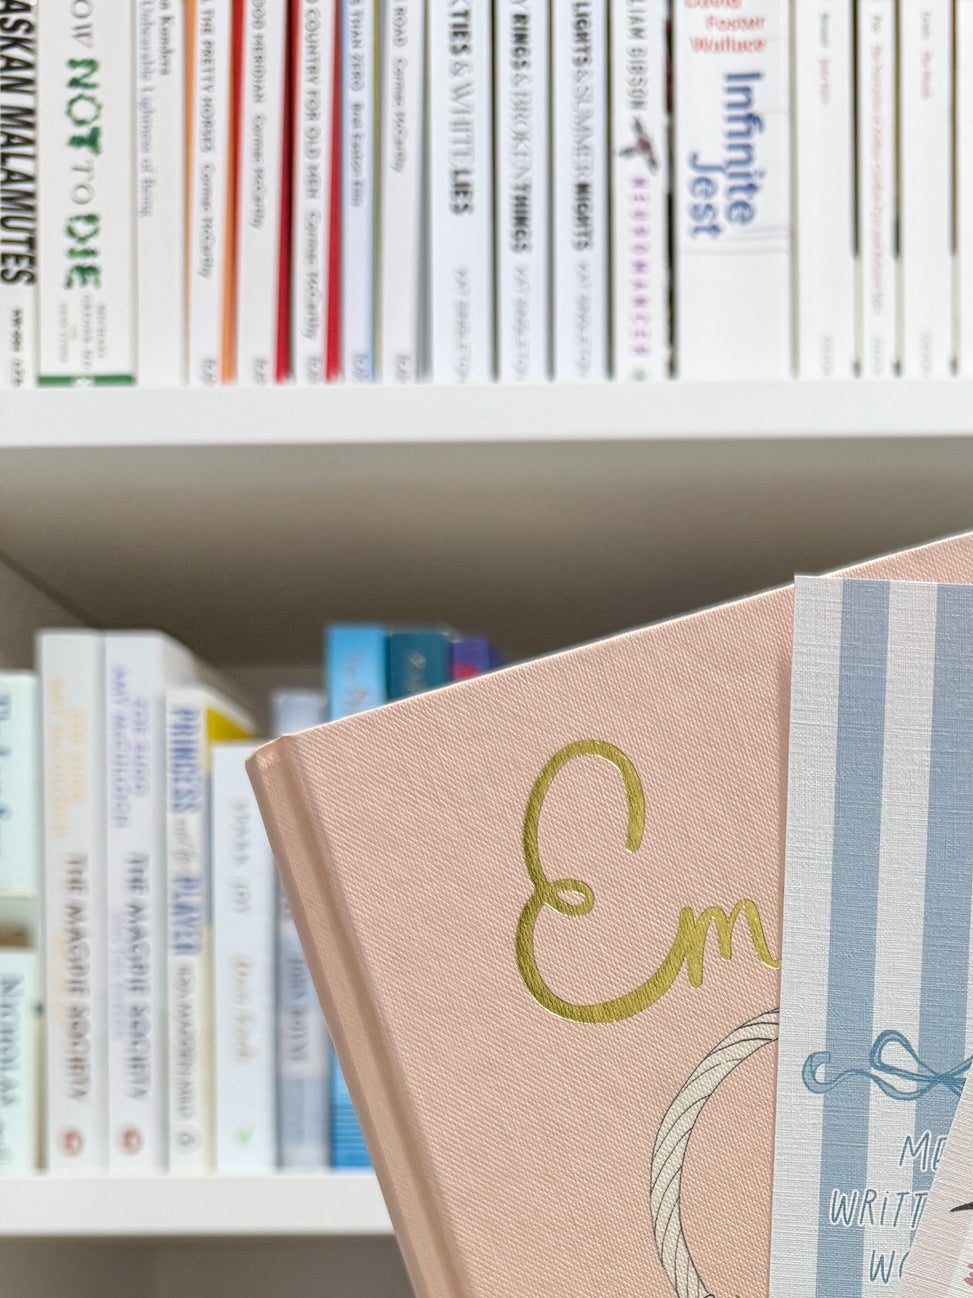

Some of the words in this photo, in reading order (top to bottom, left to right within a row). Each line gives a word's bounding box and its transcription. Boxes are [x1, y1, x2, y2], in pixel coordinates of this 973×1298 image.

[304, 9, 321, 85] COUNTRY
[448, 8, 473, 57] TIES
[510, 13, 532, 70] RINGS
[65, 58, 102, 157] NOT
[304, 90, 321, 121] FOR
[627, 46, 649, 112] GIBSON
[304, 126, 321, 160] OLD
[723, 72, 765, 226] Infinite
[0, 106, 35, 287] MALAMUTES
[71, 160, 95, 205] TO
[303, 165, 320, 199] MEN
[448, 168, 474, 217] LIES
[509, 182, 532, 255] THINGS
[571, 180, 594, 252] NIGHTS
[687, 151, 723, 238] Jest
[64, 213, 100, 289] DIE
[169, 708, 198, 815] PRINCESS
[170, 875, 199, 956] PLAYER
[515, 739, 780, 1024] Em
[64, 901, 90, 997] MAGPIE
[126, 900, 152, 996] MAGPIE
[831, 1188, 928, 1229] WRITT
